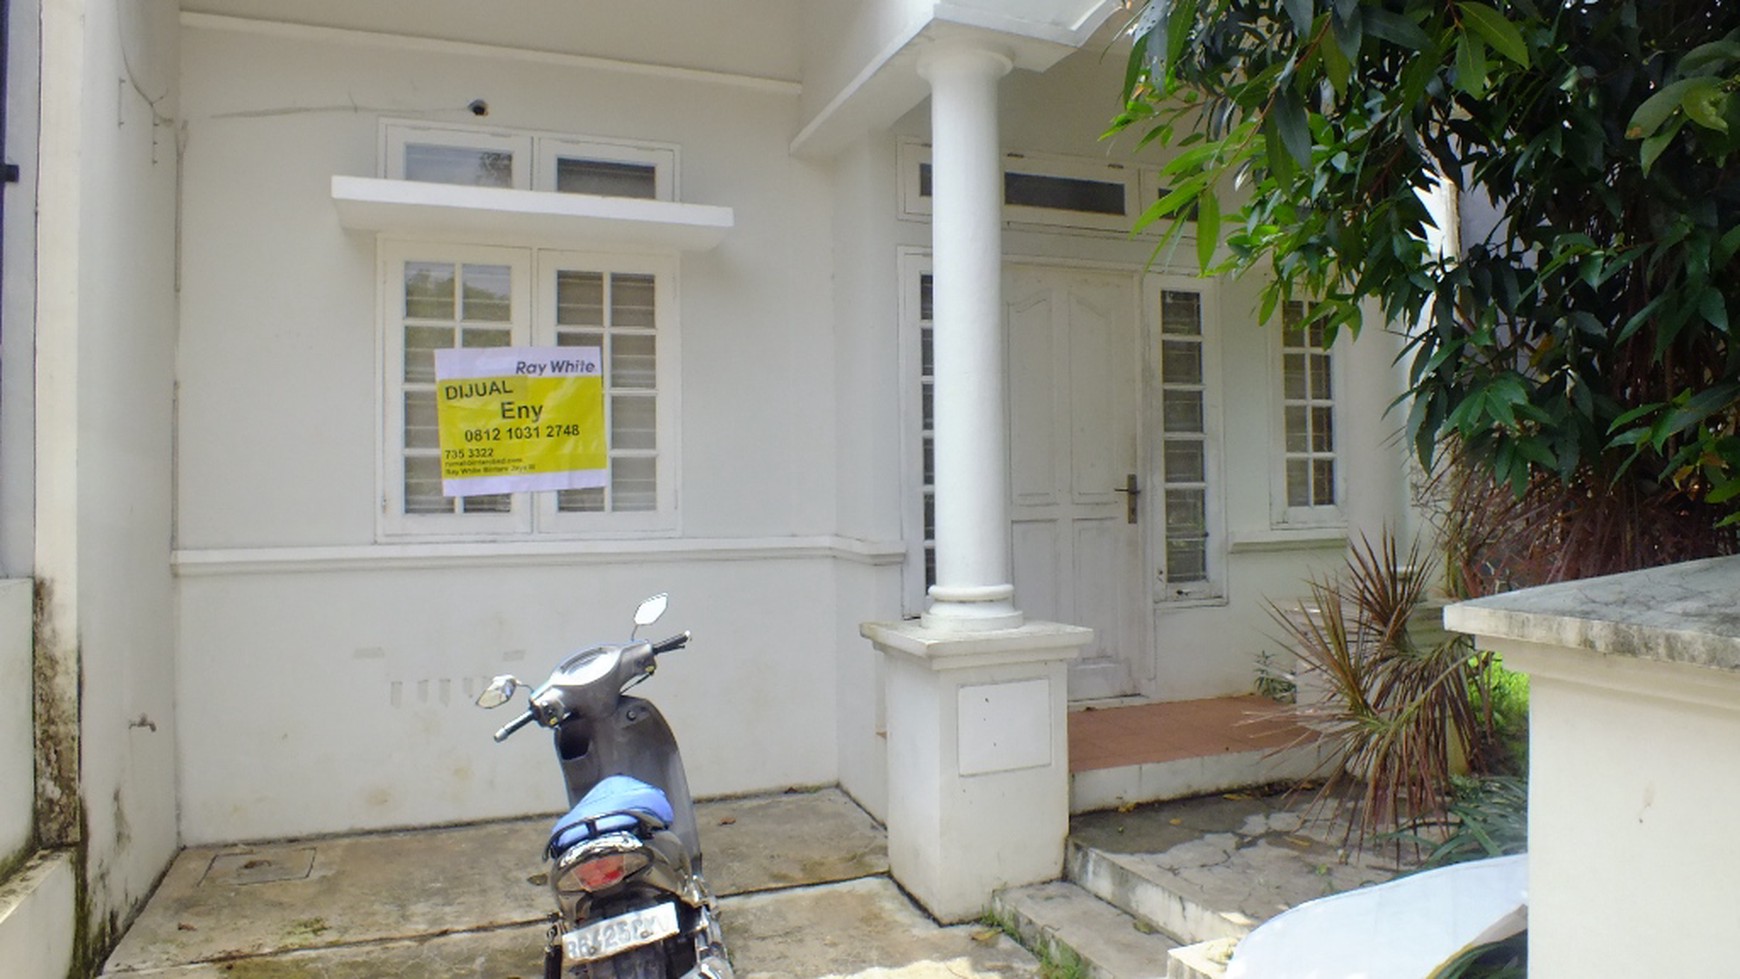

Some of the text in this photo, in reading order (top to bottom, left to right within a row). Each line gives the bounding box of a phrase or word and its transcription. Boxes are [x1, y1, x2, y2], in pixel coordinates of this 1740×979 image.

[515, 360, 595, 376] Ray White
[445, 380, 514, 401] DIJUAL
[501, 401, 543, 422] Eny
[464, 424, 580, 442] 0812 1031 2748
[445, 448, 494, 459] 735 3322
